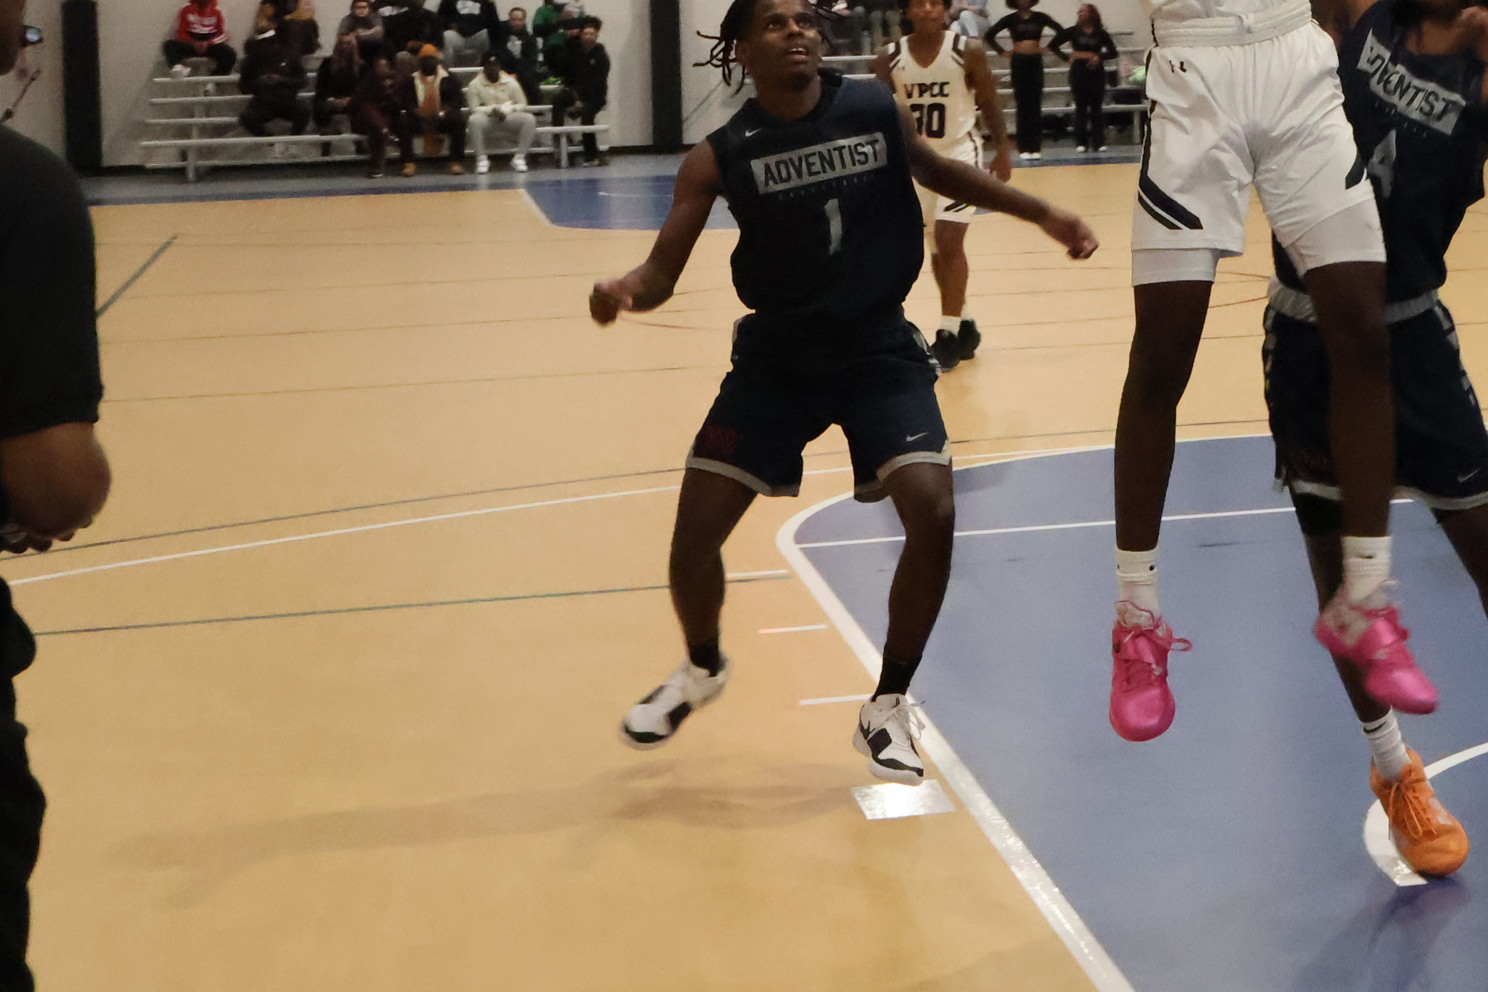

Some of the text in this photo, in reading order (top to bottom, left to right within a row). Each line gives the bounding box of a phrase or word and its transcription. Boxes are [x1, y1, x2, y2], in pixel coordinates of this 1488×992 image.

[904, 81, 950, 99] VPCC
[764, 139, 879, 188] ADVENTIST
[824, 198, 843, 255] 1
